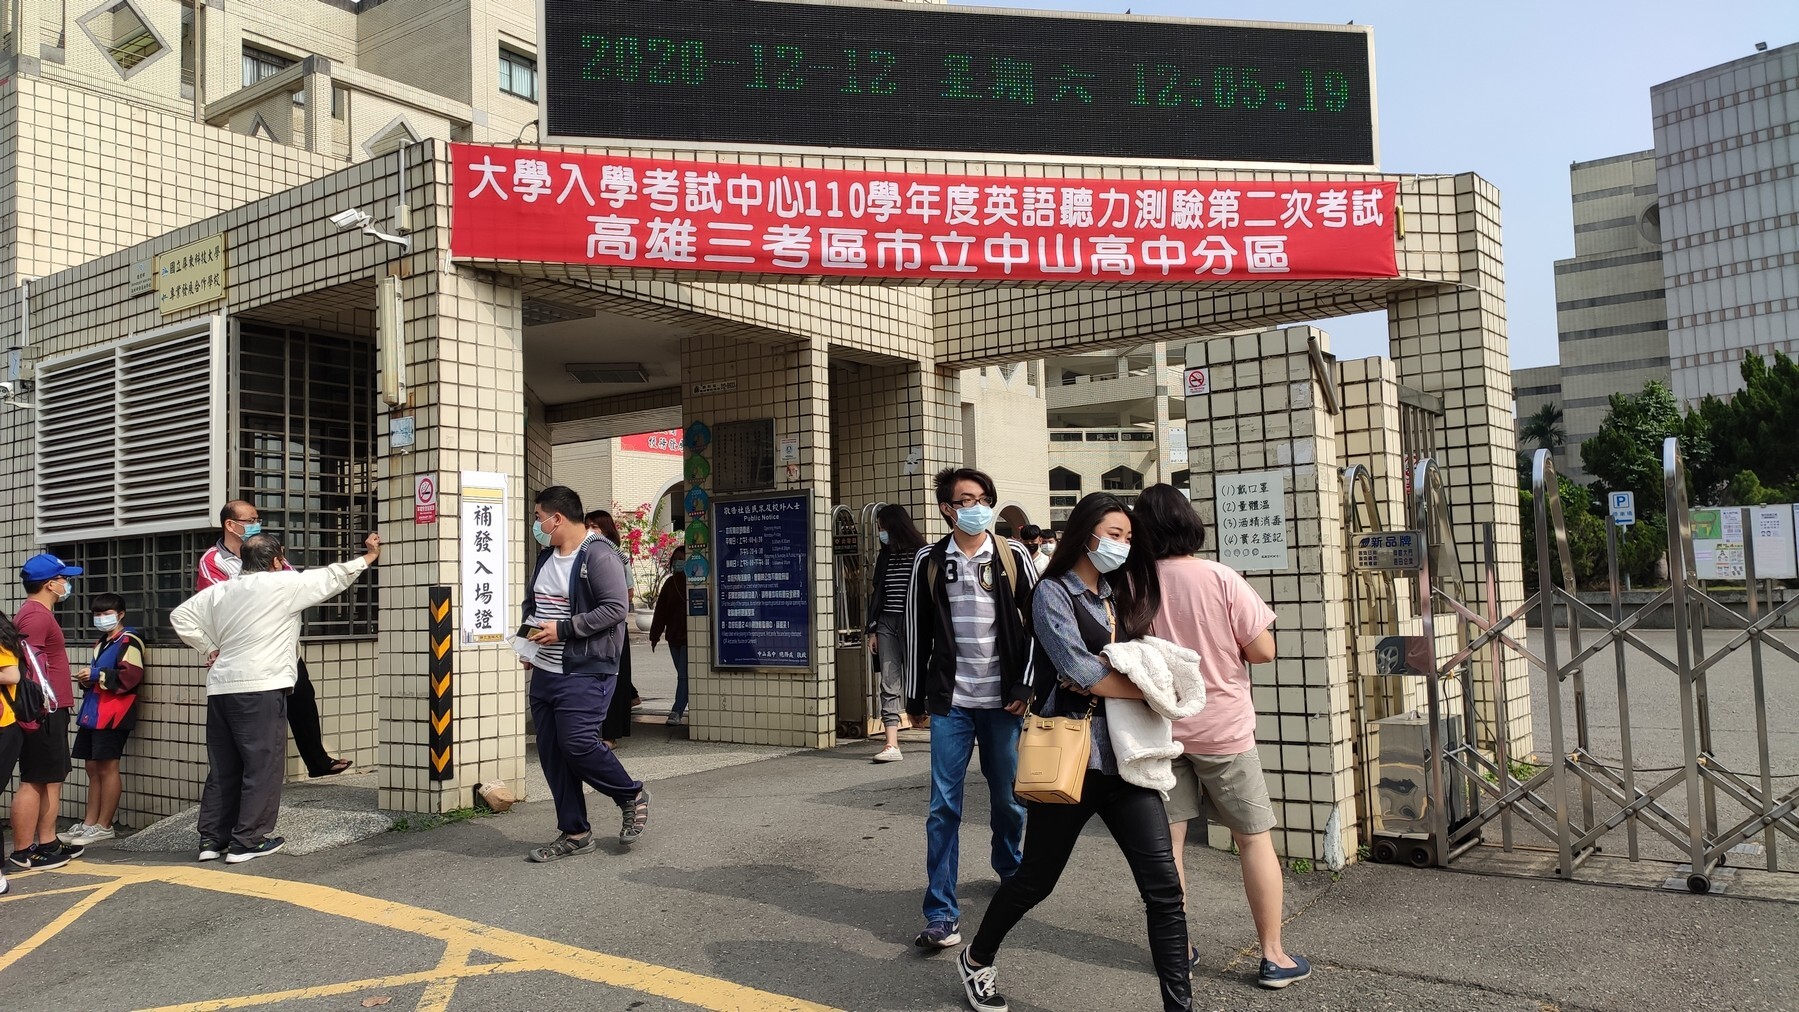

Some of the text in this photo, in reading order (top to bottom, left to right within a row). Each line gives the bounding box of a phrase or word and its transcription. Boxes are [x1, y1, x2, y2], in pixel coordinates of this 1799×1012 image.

[582, 35, 897, 94] 2020-12-12
[1130, 63, 1350, 112] 12:05:19
[468, 155, 1384, 229] 大學入學考試中心110學年度英語聽力測驗第二次考試
[586, 213, 1290, 276] 高雄三考區市立中山高中分區
[474, 505, 494, 630] 補發入場證
[1370, 535, 1412, 548] 新品牌
